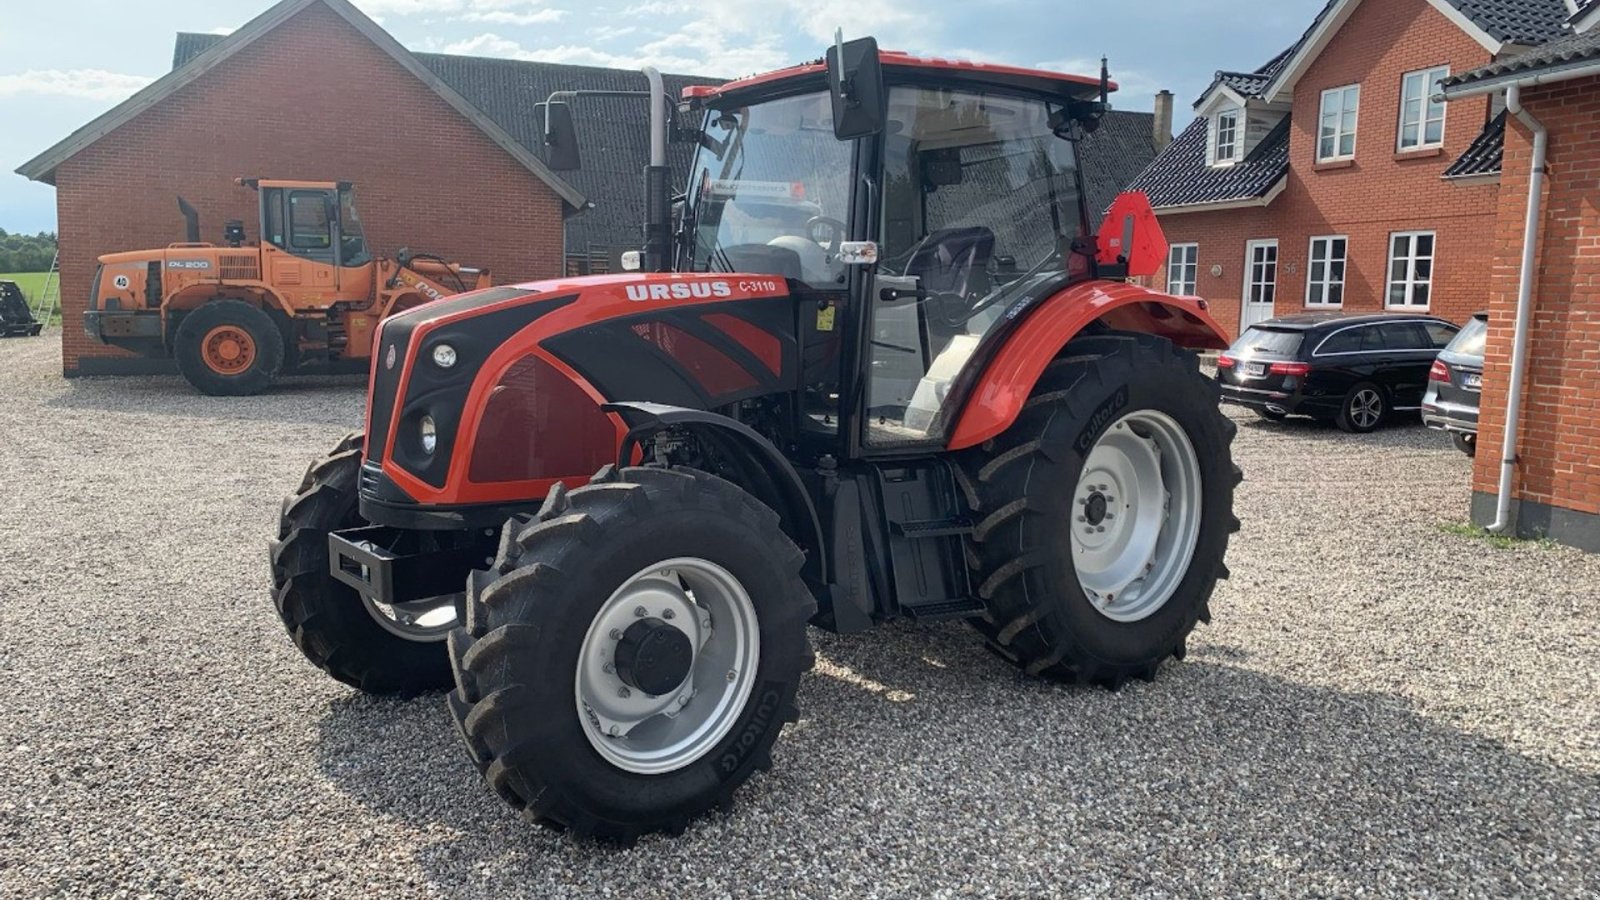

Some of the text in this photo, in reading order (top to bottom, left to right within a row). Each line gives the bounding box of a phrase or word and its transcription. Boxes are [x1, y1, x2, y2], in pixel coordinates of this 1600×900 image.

[185, 261, 209, 269] 200
[116, 277, 127, 287] 40
[625, 281, 776, 301] URSUS C-3110
